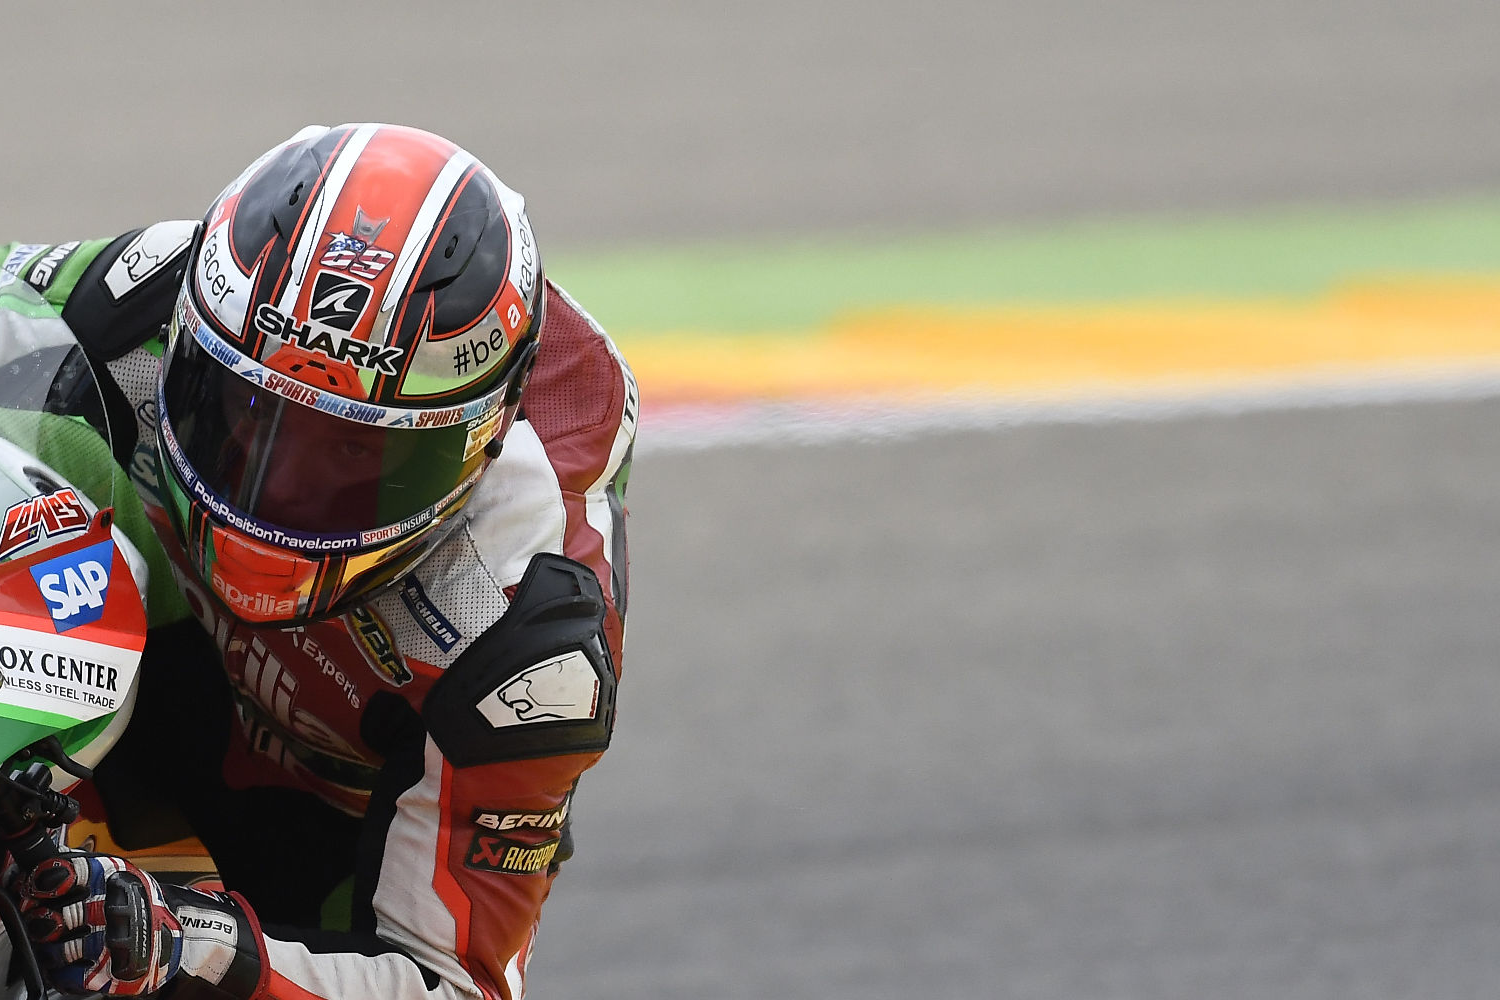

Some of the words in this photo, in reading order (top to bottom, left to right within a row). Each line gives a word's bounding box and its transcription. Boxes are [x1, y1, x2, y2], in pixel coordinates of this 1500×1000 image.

[204, 231, 235, 304] racer
[518, 211, 533, 301] racer
[254, 303, 404, 377] SHARK
[453, 327, 504, 376] #be
[264, 372, 387, 425] SPORTSBIKESHOP
[194, 480, 358, 550] PolePositionTravel.com
[363, 507, 433, 544] SPORTSINSURE
[39, 560, 109, 621] SAP
[212, 572, 295, 615] aprilia
[407, 586, 457, 645] MICHELIN
[41, 653, 118, 692] CENTER
[45, 684, 80, 701] STEEL
[82, 691, 116, 709] TRADE
[301, 637, 361, 710] Experis
[475, 799, 568, 831] BERIN
